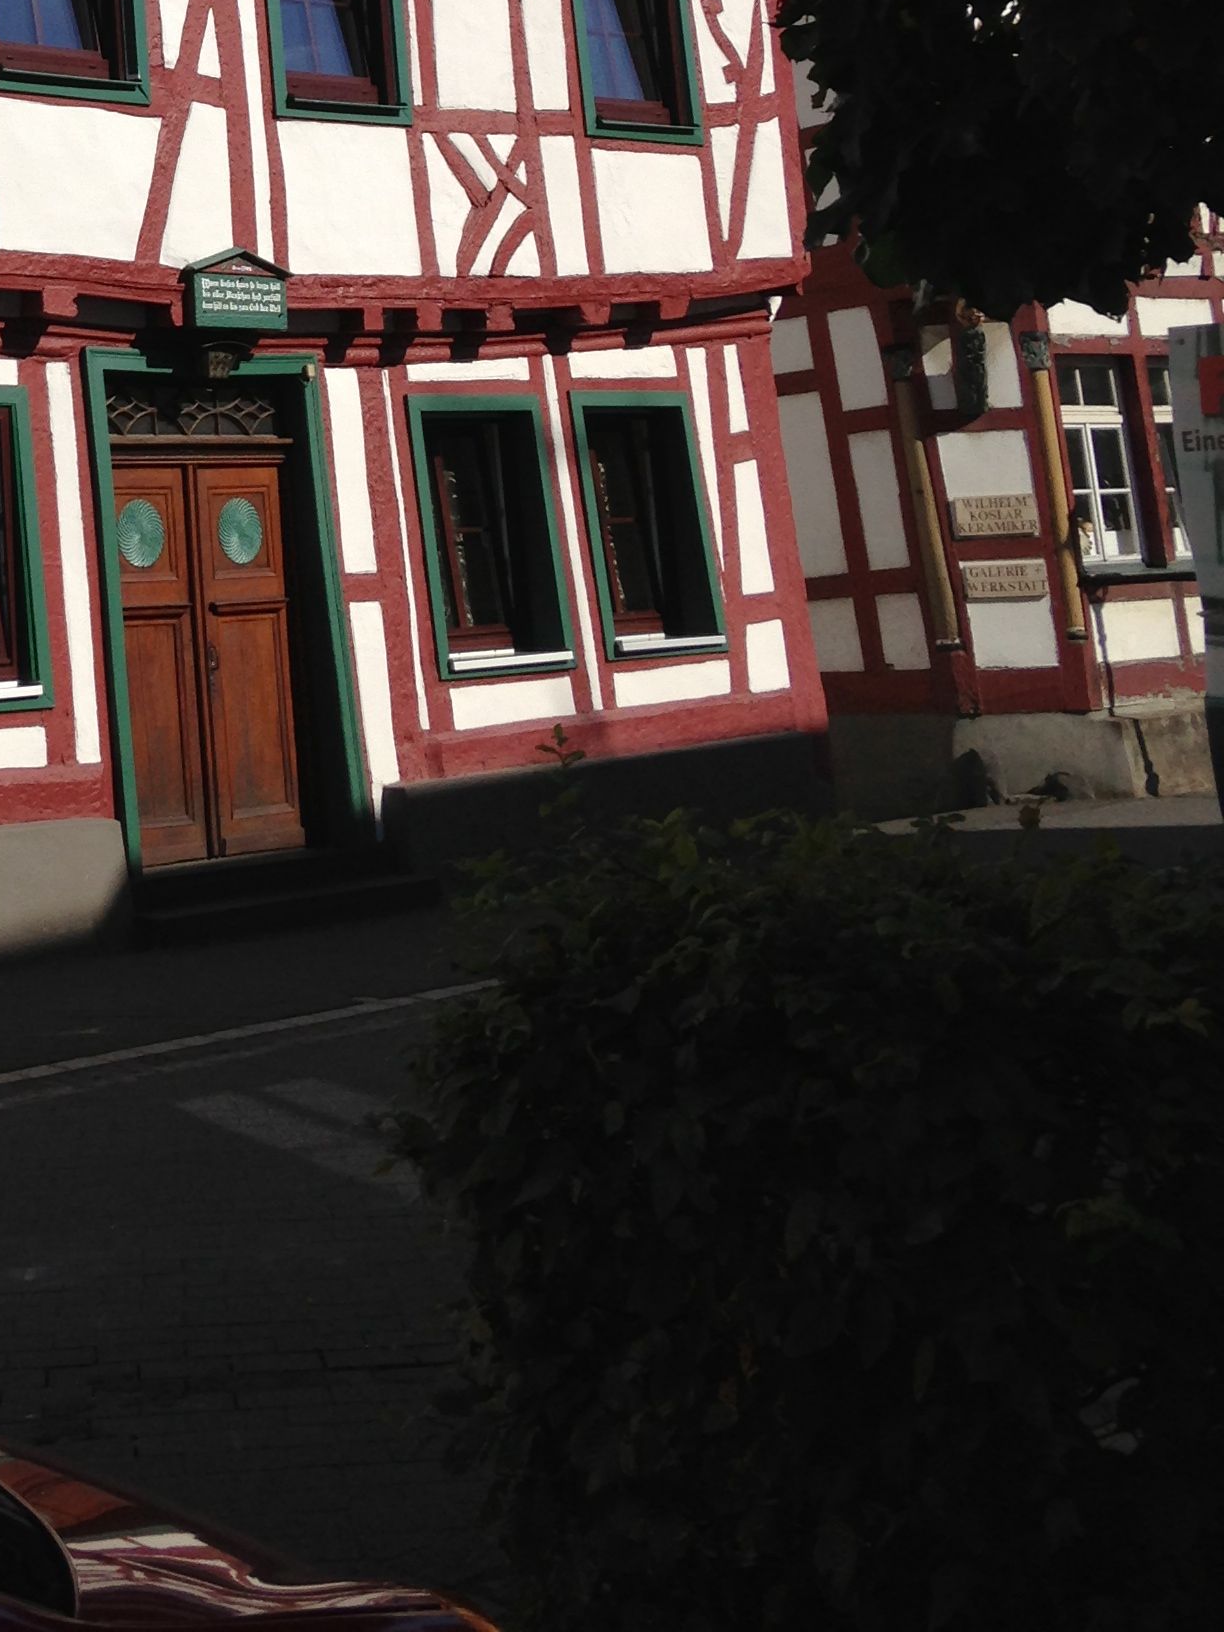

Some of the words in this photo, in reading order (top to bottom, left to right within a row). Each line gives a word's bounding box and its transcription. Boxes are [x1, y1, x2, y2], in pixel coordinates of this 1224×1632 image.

[961, 496, 1027, 509] WILHELM
[970, 509, 1023, 521] KOSLAR
[958, 520, 1037, 534] KERAMIKER
[969, 566, 1028, 577] GALERIE
[968, 580, 1048, 592] WERKSTATT
